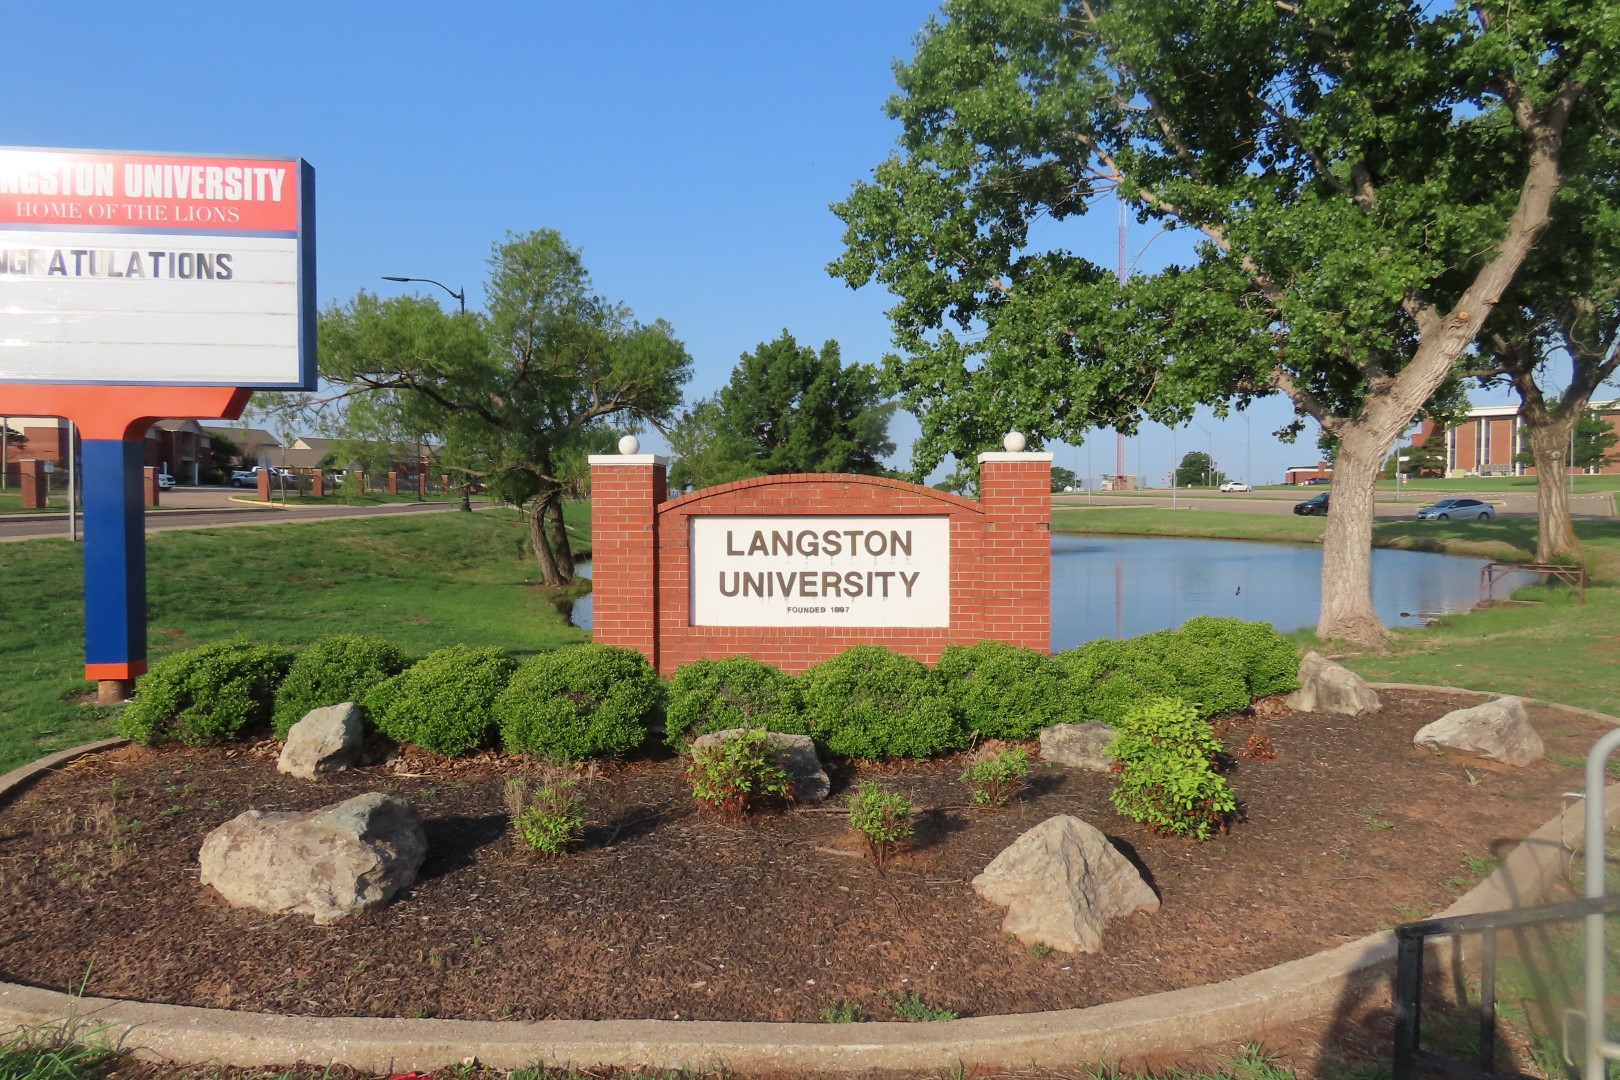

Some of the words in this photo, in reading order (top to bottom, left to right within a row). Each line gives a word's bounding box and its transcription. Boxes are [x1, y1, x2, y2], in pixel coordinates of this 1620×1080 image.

[124, 163, 286, 202] UNIVERSITY
[15, 201, 82, 219] HOME
[88, 204, 119, 220] OF
[123, 204, 168, 221] THE
[174, 205, 240, 223] LIONS
[726, 530, 912, 557] LANGSTON
[719, 571, 920, 598] UNIVERSITY
[787, 606, 826, 614] FOUNDED
[830, 606, 850, 614] 1897
